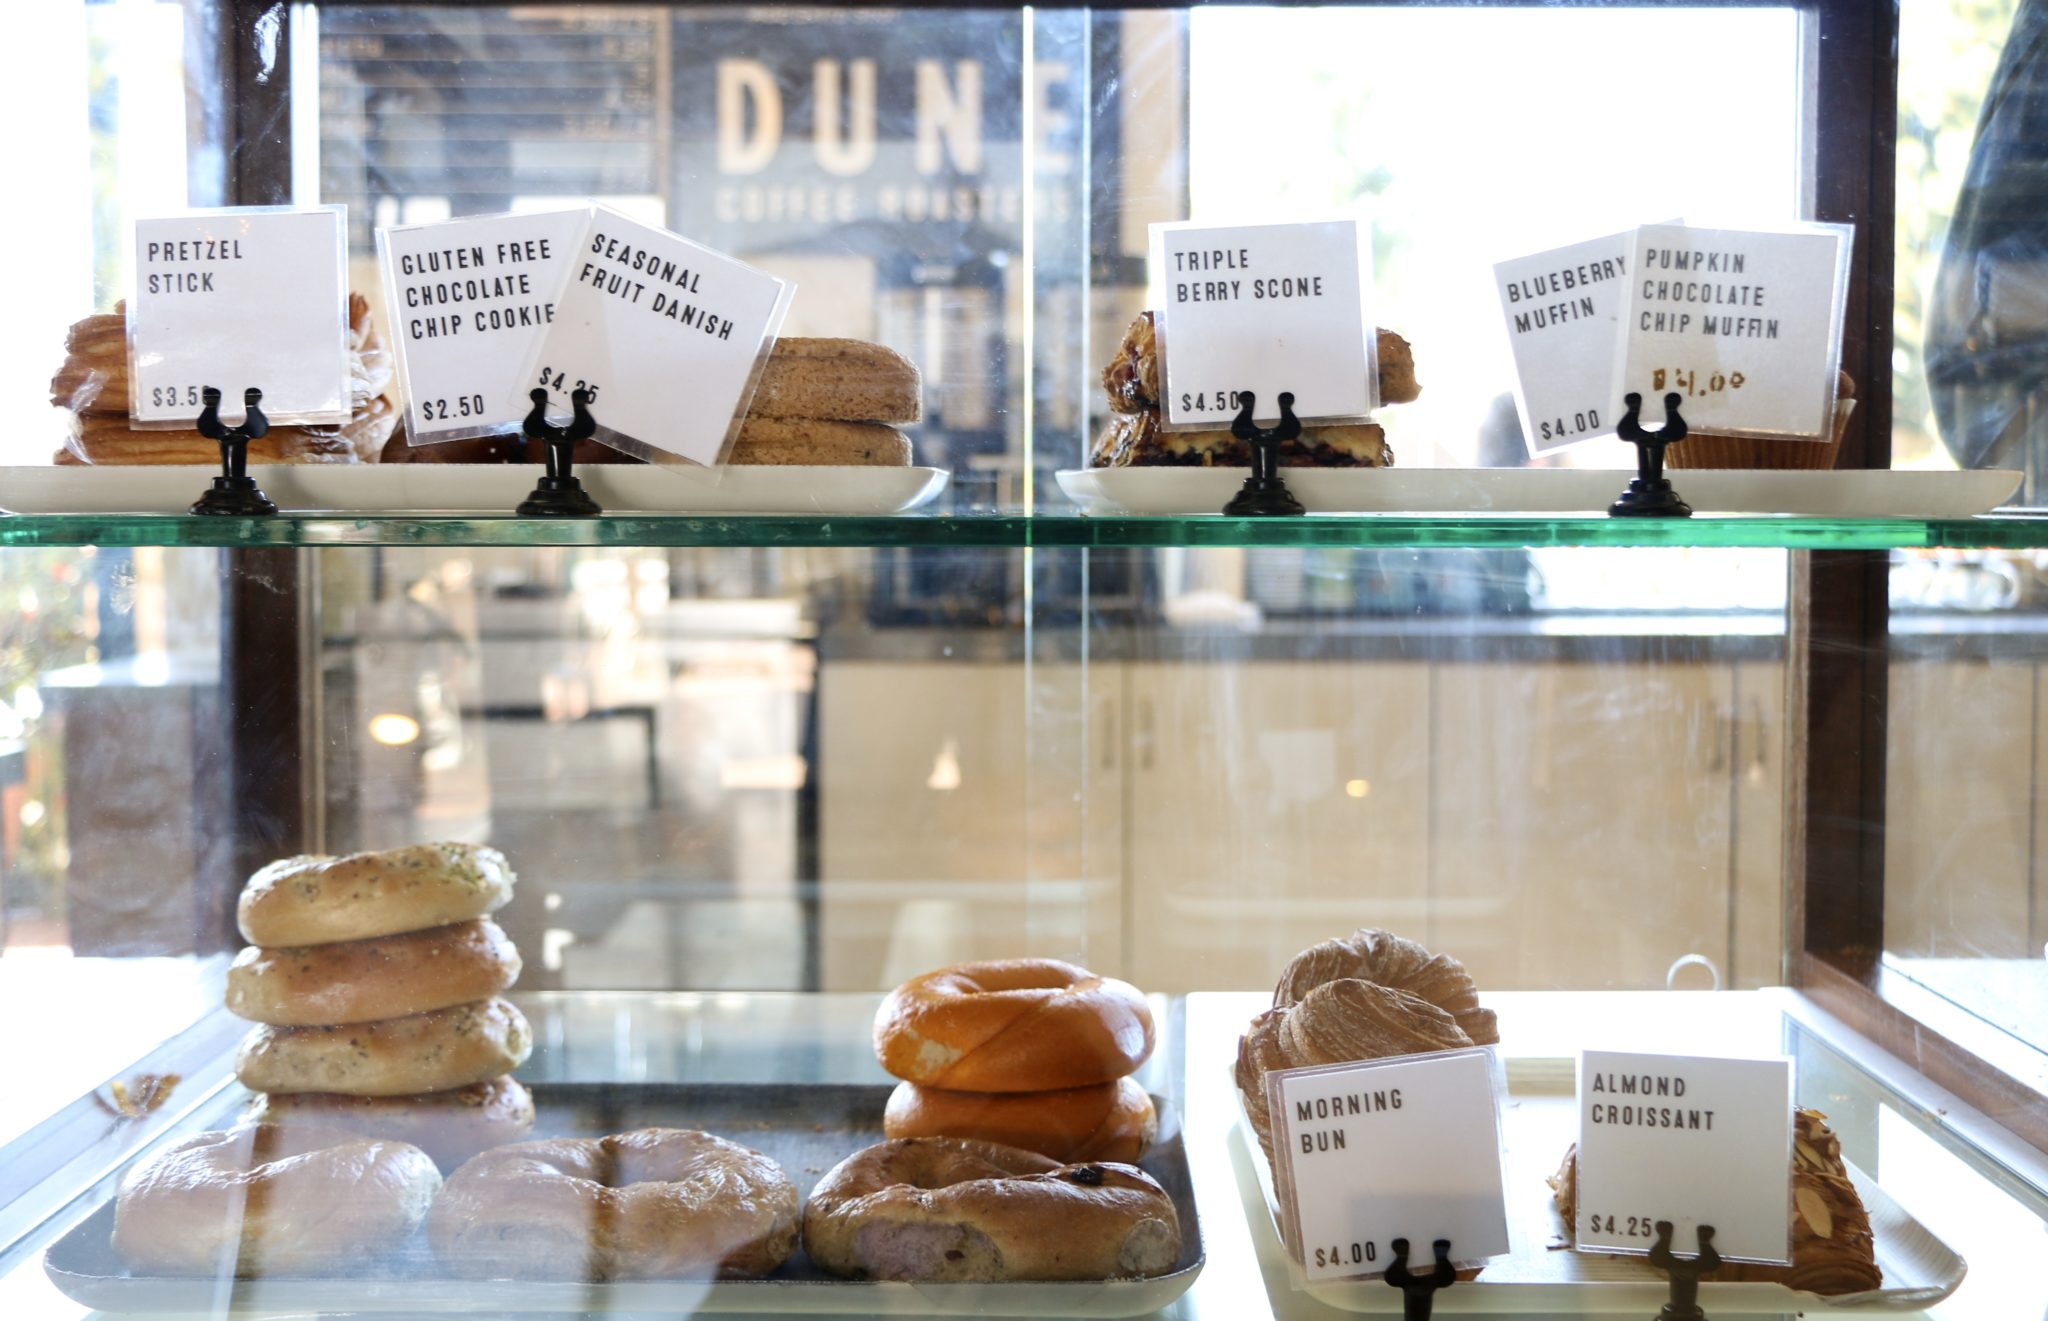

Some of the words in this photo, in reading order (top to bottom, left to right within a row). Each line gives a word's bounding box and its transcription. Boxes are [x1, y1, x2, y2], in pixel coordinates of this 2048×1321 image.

[716, 56, 1071, 176] DUNE
[148, 239, 243, 262] PRETZEL
[401, 246, 486, 276] GLUTEN
[498, 239, 552, 264] FREE
[591, 233, 702, 295] SEASONAL
[1174, 249, 1249, 272] TRIPLE
[1645, 248, 1745, 274] PUMPKIN
[148, 272, 215, 294] STICK
[405, 274, 531, 308] CHOCOLATE
[1177, 281, 1241, 303] BERRY
[1254, 277, 1323, 299] SCONE
[1507, 256, 1627, 303] BLUEBERRY
[579, 263, 647, 304] FRUIT
[652, 292, 735, 341] DANISH
[1642, 280, 1765, 307] CHOCOLATE
[410, 315, 462, 340] CHIP
[475, 303, 556, 332] COOKIE
[1514, 297, 1596, 334] MUFFIN
[1640, 312, 1691, 334] CHIP
[1703, 316, 1779, 339] MUFFIN
[152, 385, 208, 407] $3.5
[423, 394, 485, 421] $2.50
[1182, 391, 1239, 412] $4.50
[1541, 409, 1601, 441] $4.00
[1593, 1073, 1686, 1097] ALMOND
[1297, 1089, 1403, 1121] MORNING
[1592, 1104, 1714, 1131] CROISSANT
[1300, 1129, 1347, 1154] BUN
[1591, 1214, 1652, 1237] $4.25
[1315, 1241, 1377, 1268] $4.00
